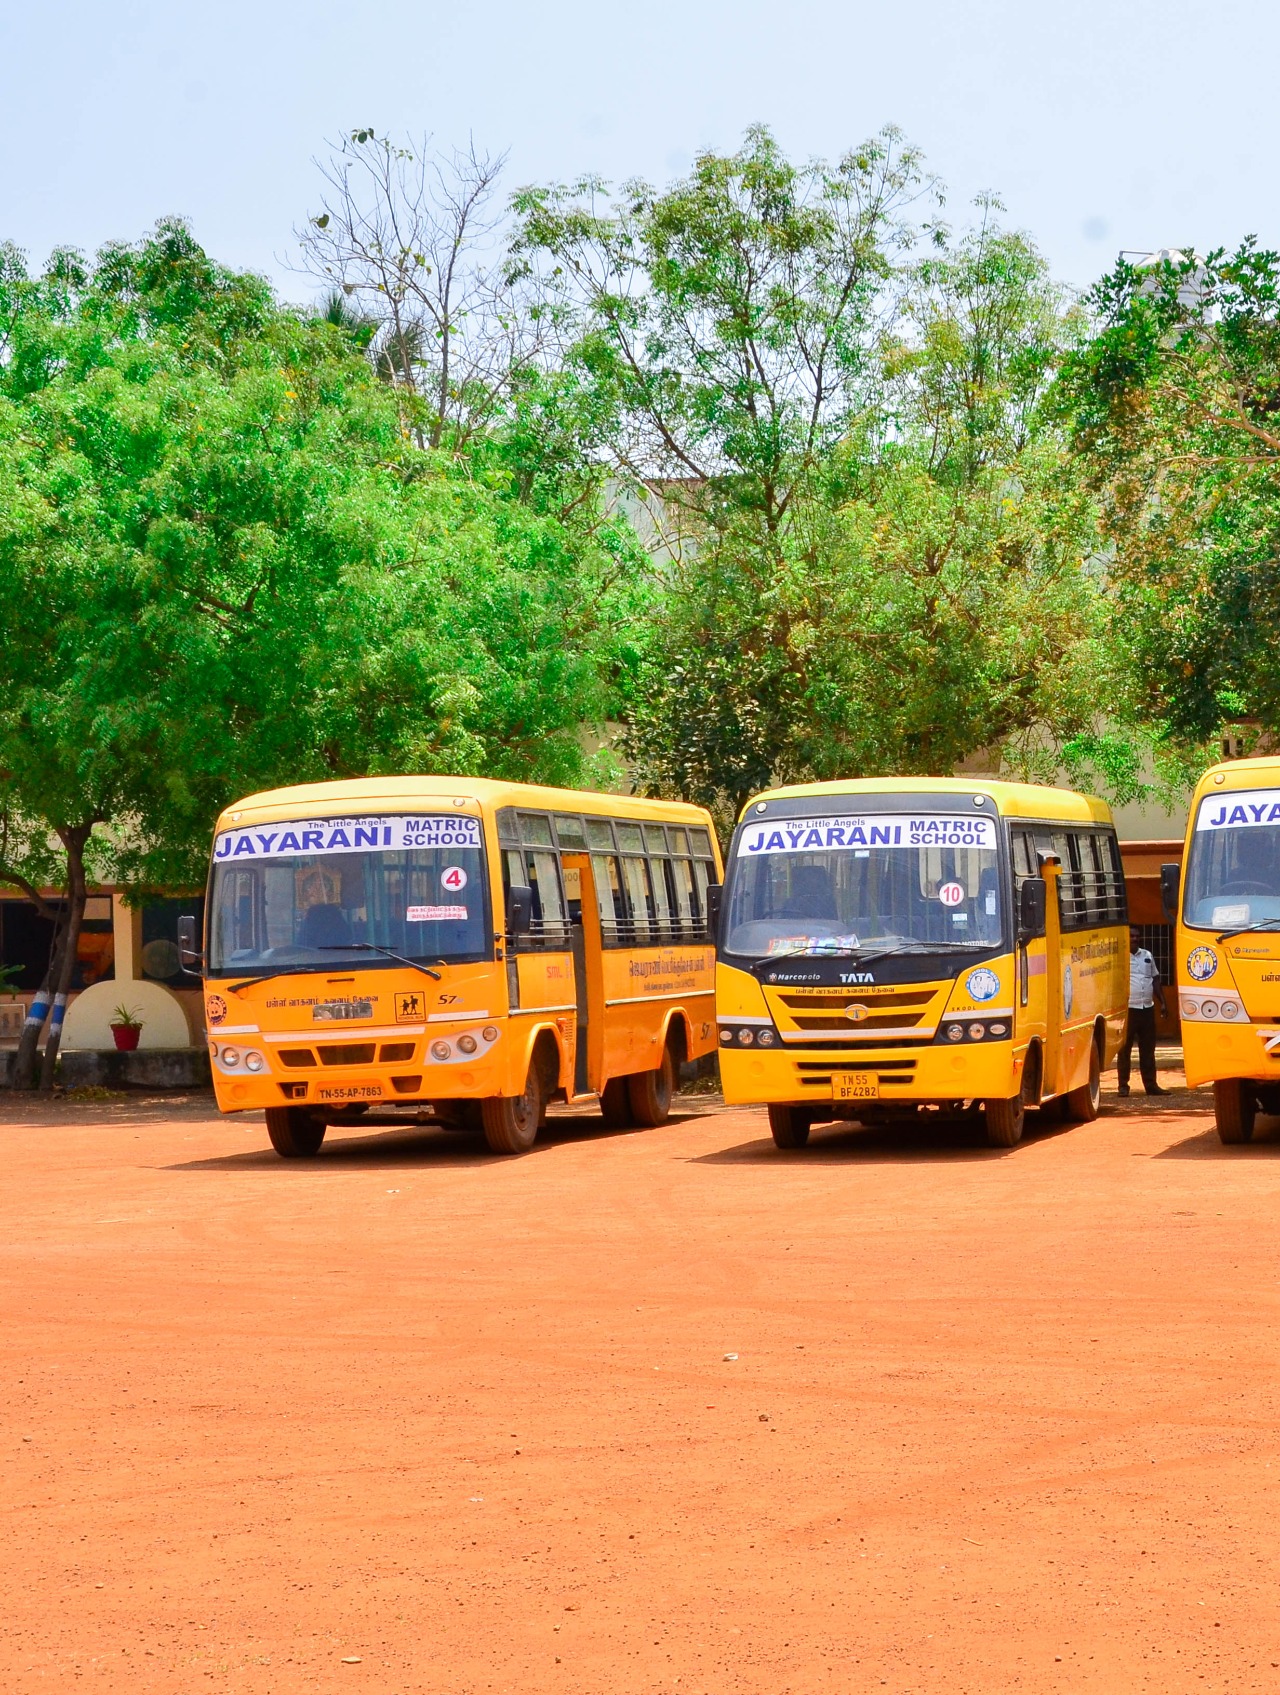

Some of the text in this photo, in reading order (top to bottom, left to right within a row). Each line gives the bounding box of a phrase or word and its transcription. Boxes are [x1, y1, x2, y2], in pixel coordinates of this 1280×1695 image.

[328, 820, 352, 828] Little
[354, 819, 387, 827] Angels
[406, 820, 476, 832] MATRIC
[806, 820, 830, 828] Little
[834, 818, 866, 828] Angels
[910, 820, 987, 832] MATRIC
[216, 826, 392, 858] JAYARANI
[402, 833, 478, 846] SCHOOL
[748, 826, 902, 851] JAYARANI
[910, 833, 986, 845] SCHOOL
[445, 870, 461, 886] 4
[944, 886, 960, 902] 10
[840, 972, 874, 983] TATA
[438, 994, 457, 1004] S7
[842, 1075, 868, 1085] TN 55
[320, 1086, 382, 1098] TN-55-AP-7863
[840, 1086, 876, 1097] BF 4282
